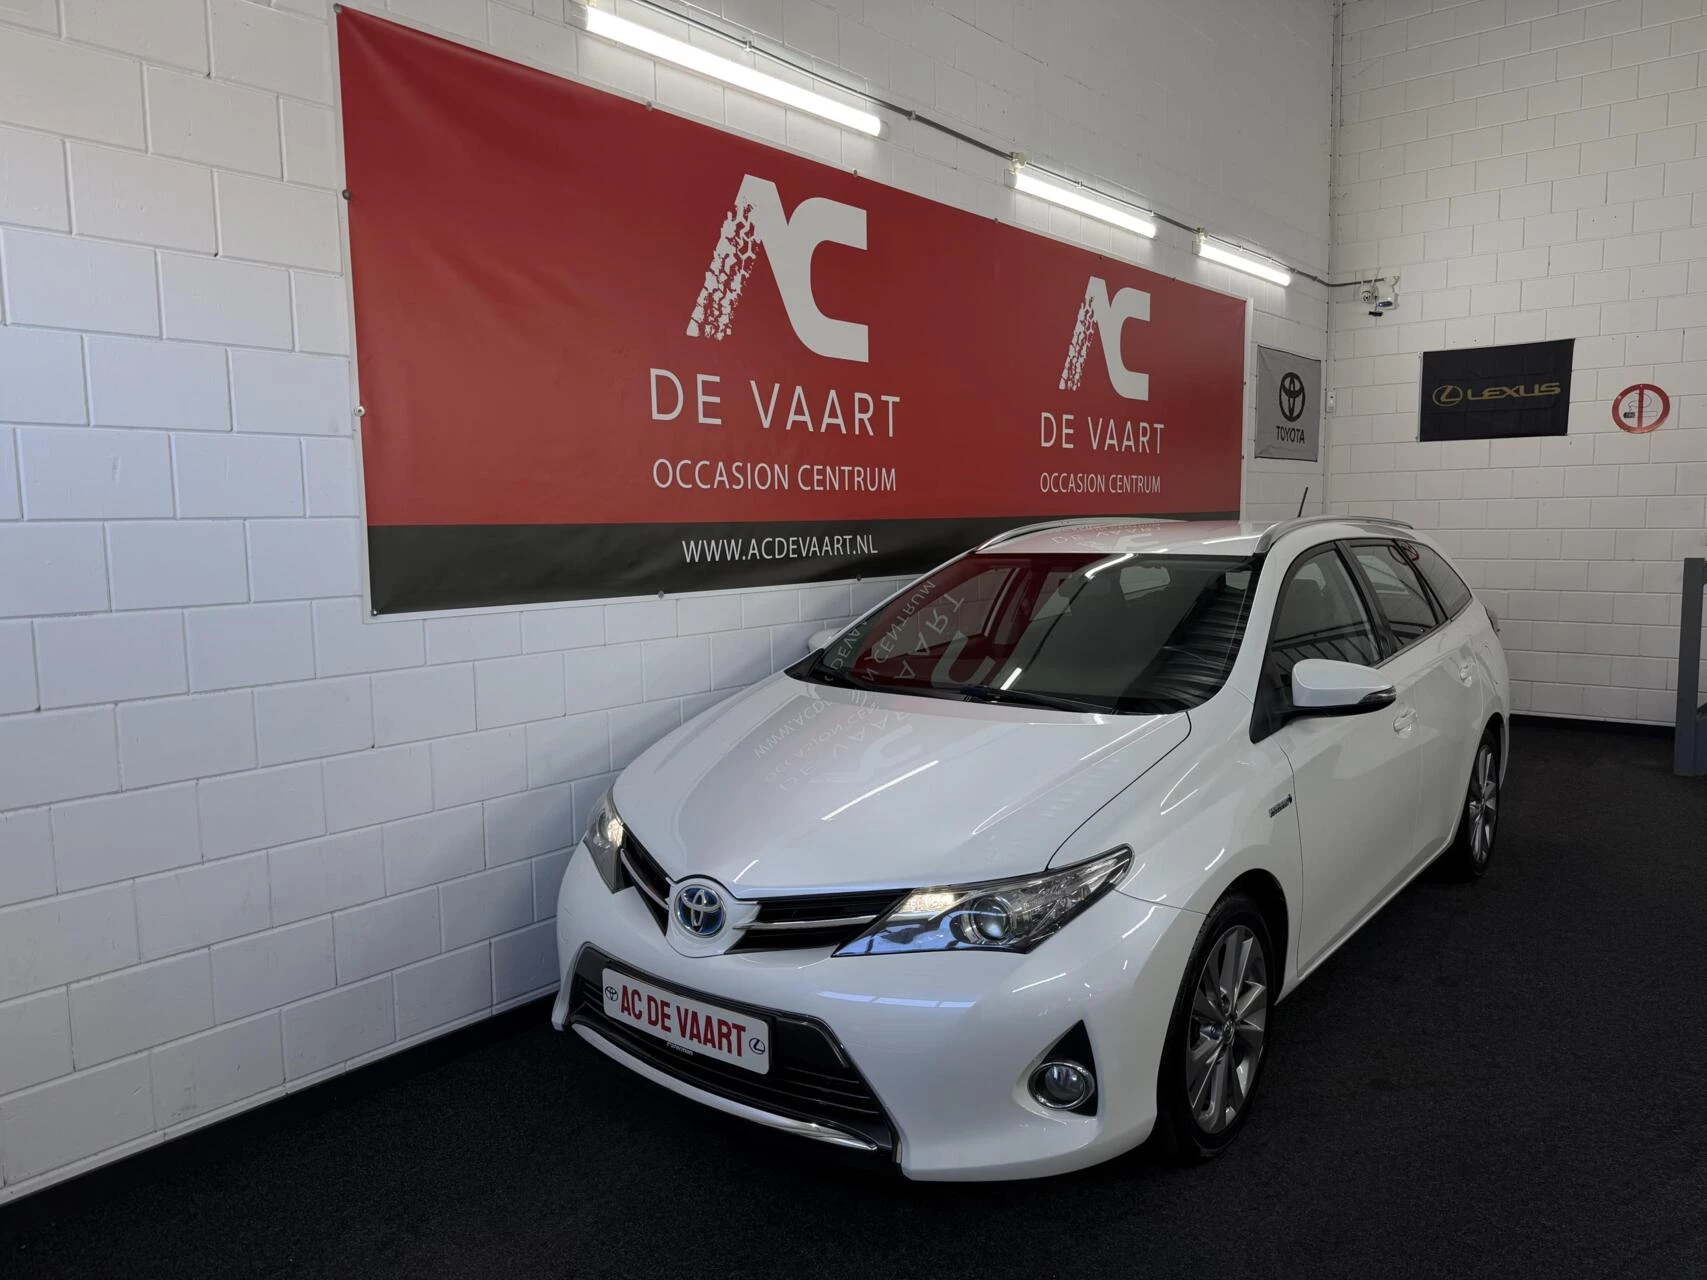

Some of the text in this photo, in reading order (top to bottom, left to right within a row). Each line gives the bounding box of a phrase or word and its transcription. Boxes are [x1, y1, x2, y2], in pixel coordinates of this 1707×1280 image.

[686, 173, 869, 363] AC
[1058, 275, 1151, 401] AC
[650, 367, 900, 438] DE VAART
[1466, 382, 1561, 400] LEXUS
[1040, 411, 1165, 454] DE VAART
[1275, 425, 1305, 444] TOYOTA
[652, 458, 897, 492] OCCASION CENTRUM
[1040, 472, 1161, 493] OCCASION CENTRUM
[681, 534, 879, 563] WWW.ACDEVAART.NL
[621, 984, 746, 1057] AC DE VAART
